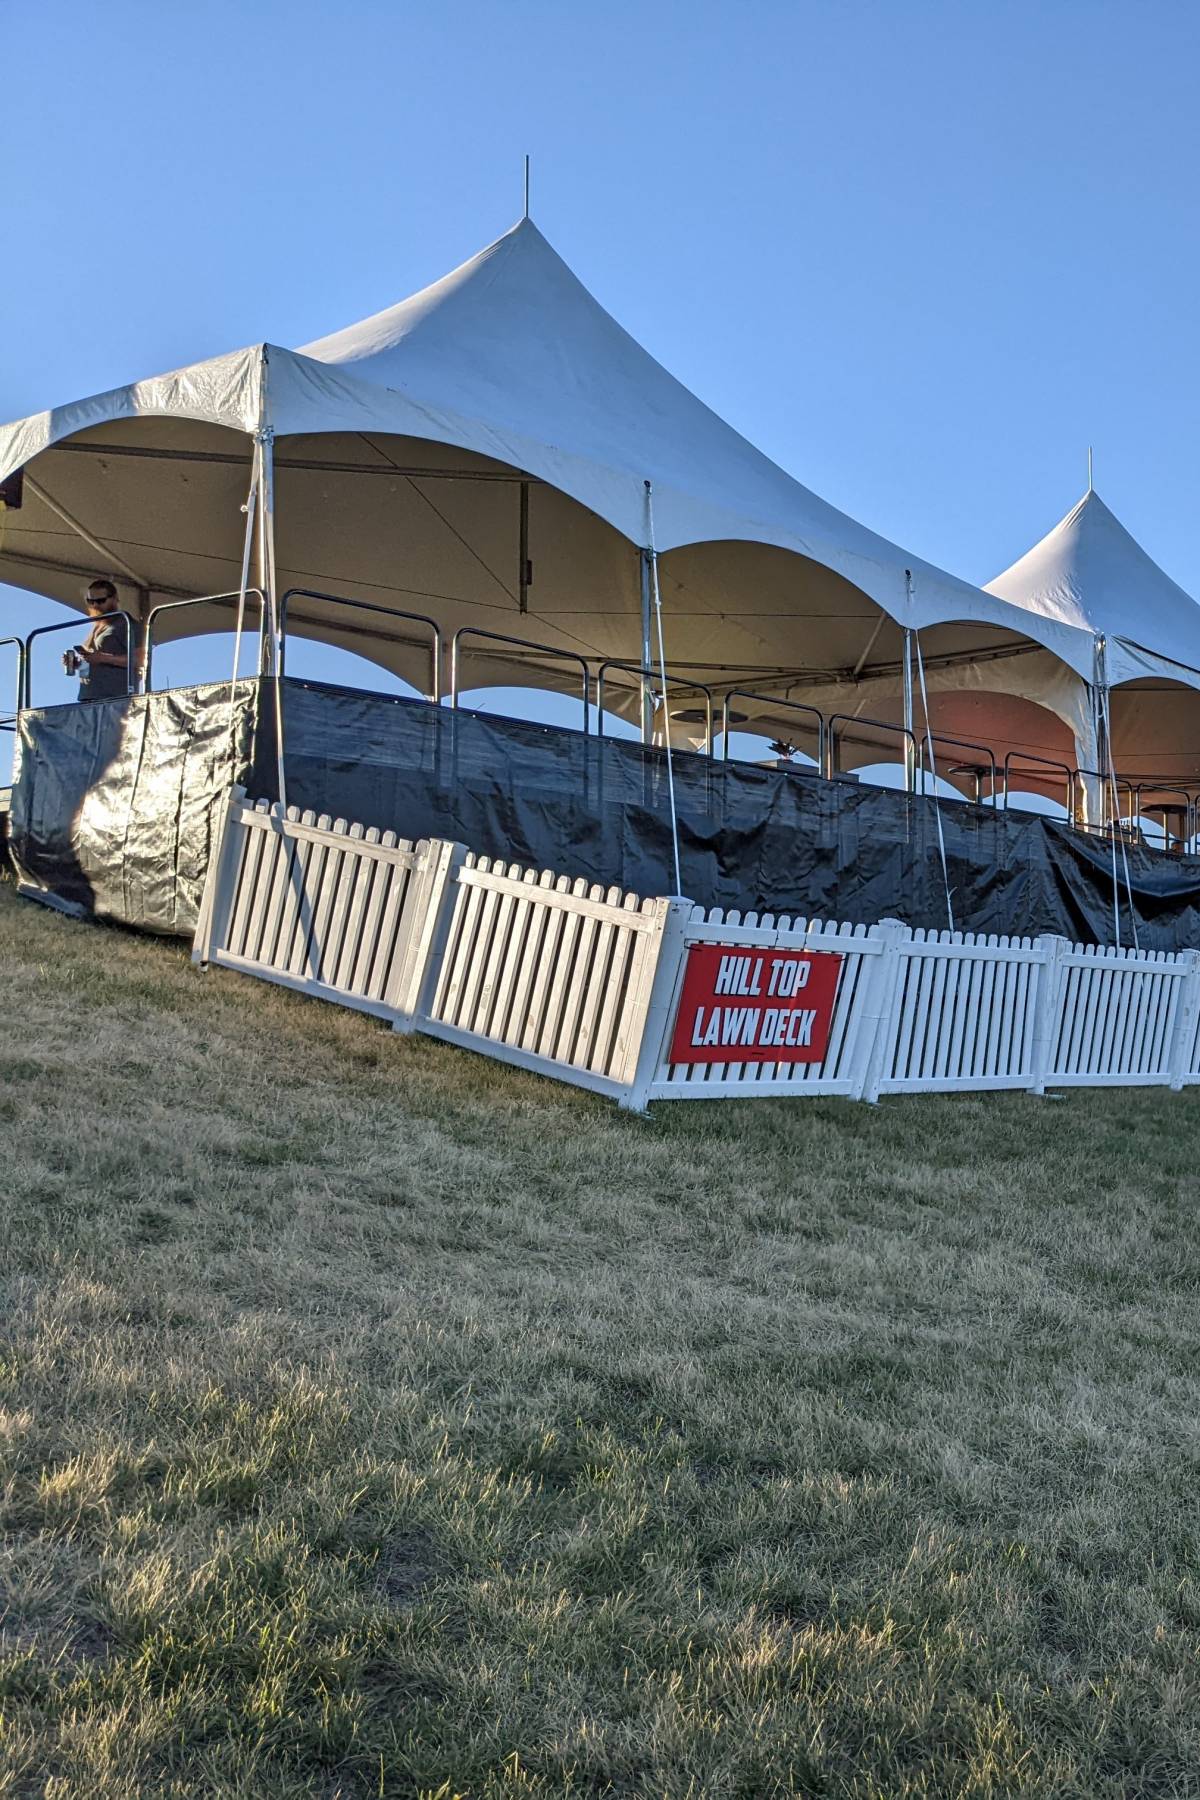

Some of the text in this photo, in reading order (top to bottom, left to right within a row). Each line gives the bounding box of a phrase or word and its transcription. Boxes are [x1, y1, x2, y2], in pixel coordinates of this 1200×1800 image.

[714, 955, 811, 998] HILL TOP
[690, 1006, 816, 1047] LAWN DECK
